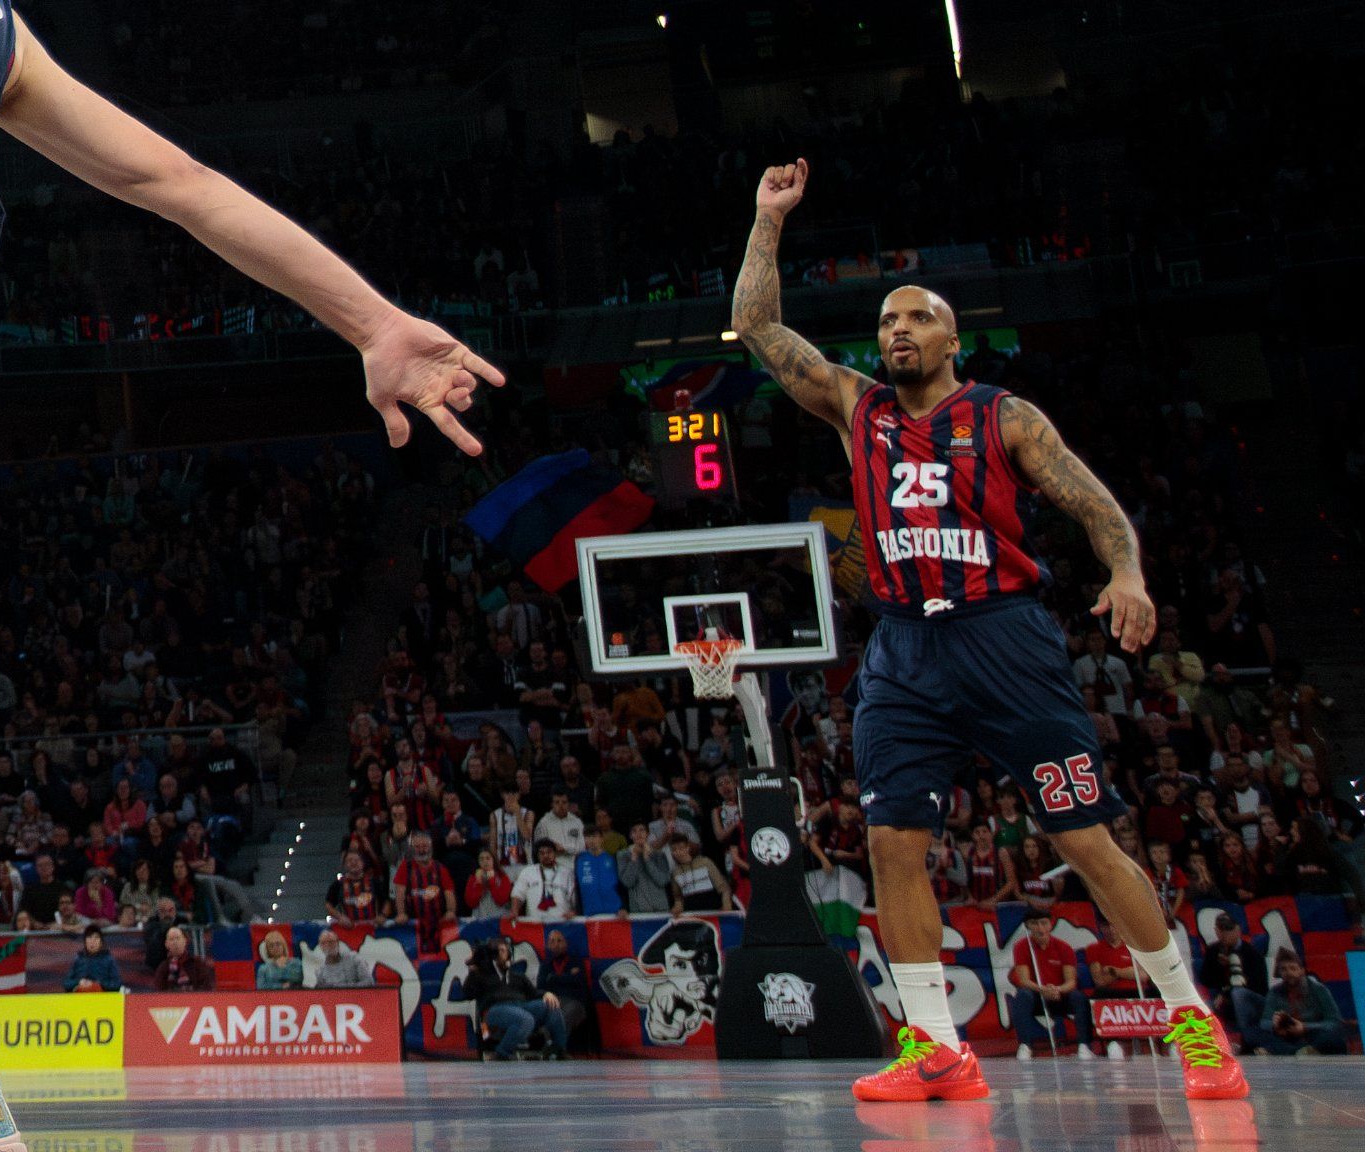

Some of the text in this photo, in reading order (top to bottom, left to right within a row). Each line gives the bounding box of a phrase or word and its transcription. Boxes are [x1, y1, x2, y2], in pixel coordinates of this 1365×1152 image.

[668, 412, 720, 443] 3:21
[694, 444, 722, 490] 6
[890, 461, 950, 509] 25
[1032, 752, 1101, 814] 25
[190, 1004, 373, 1045] AMBAR
